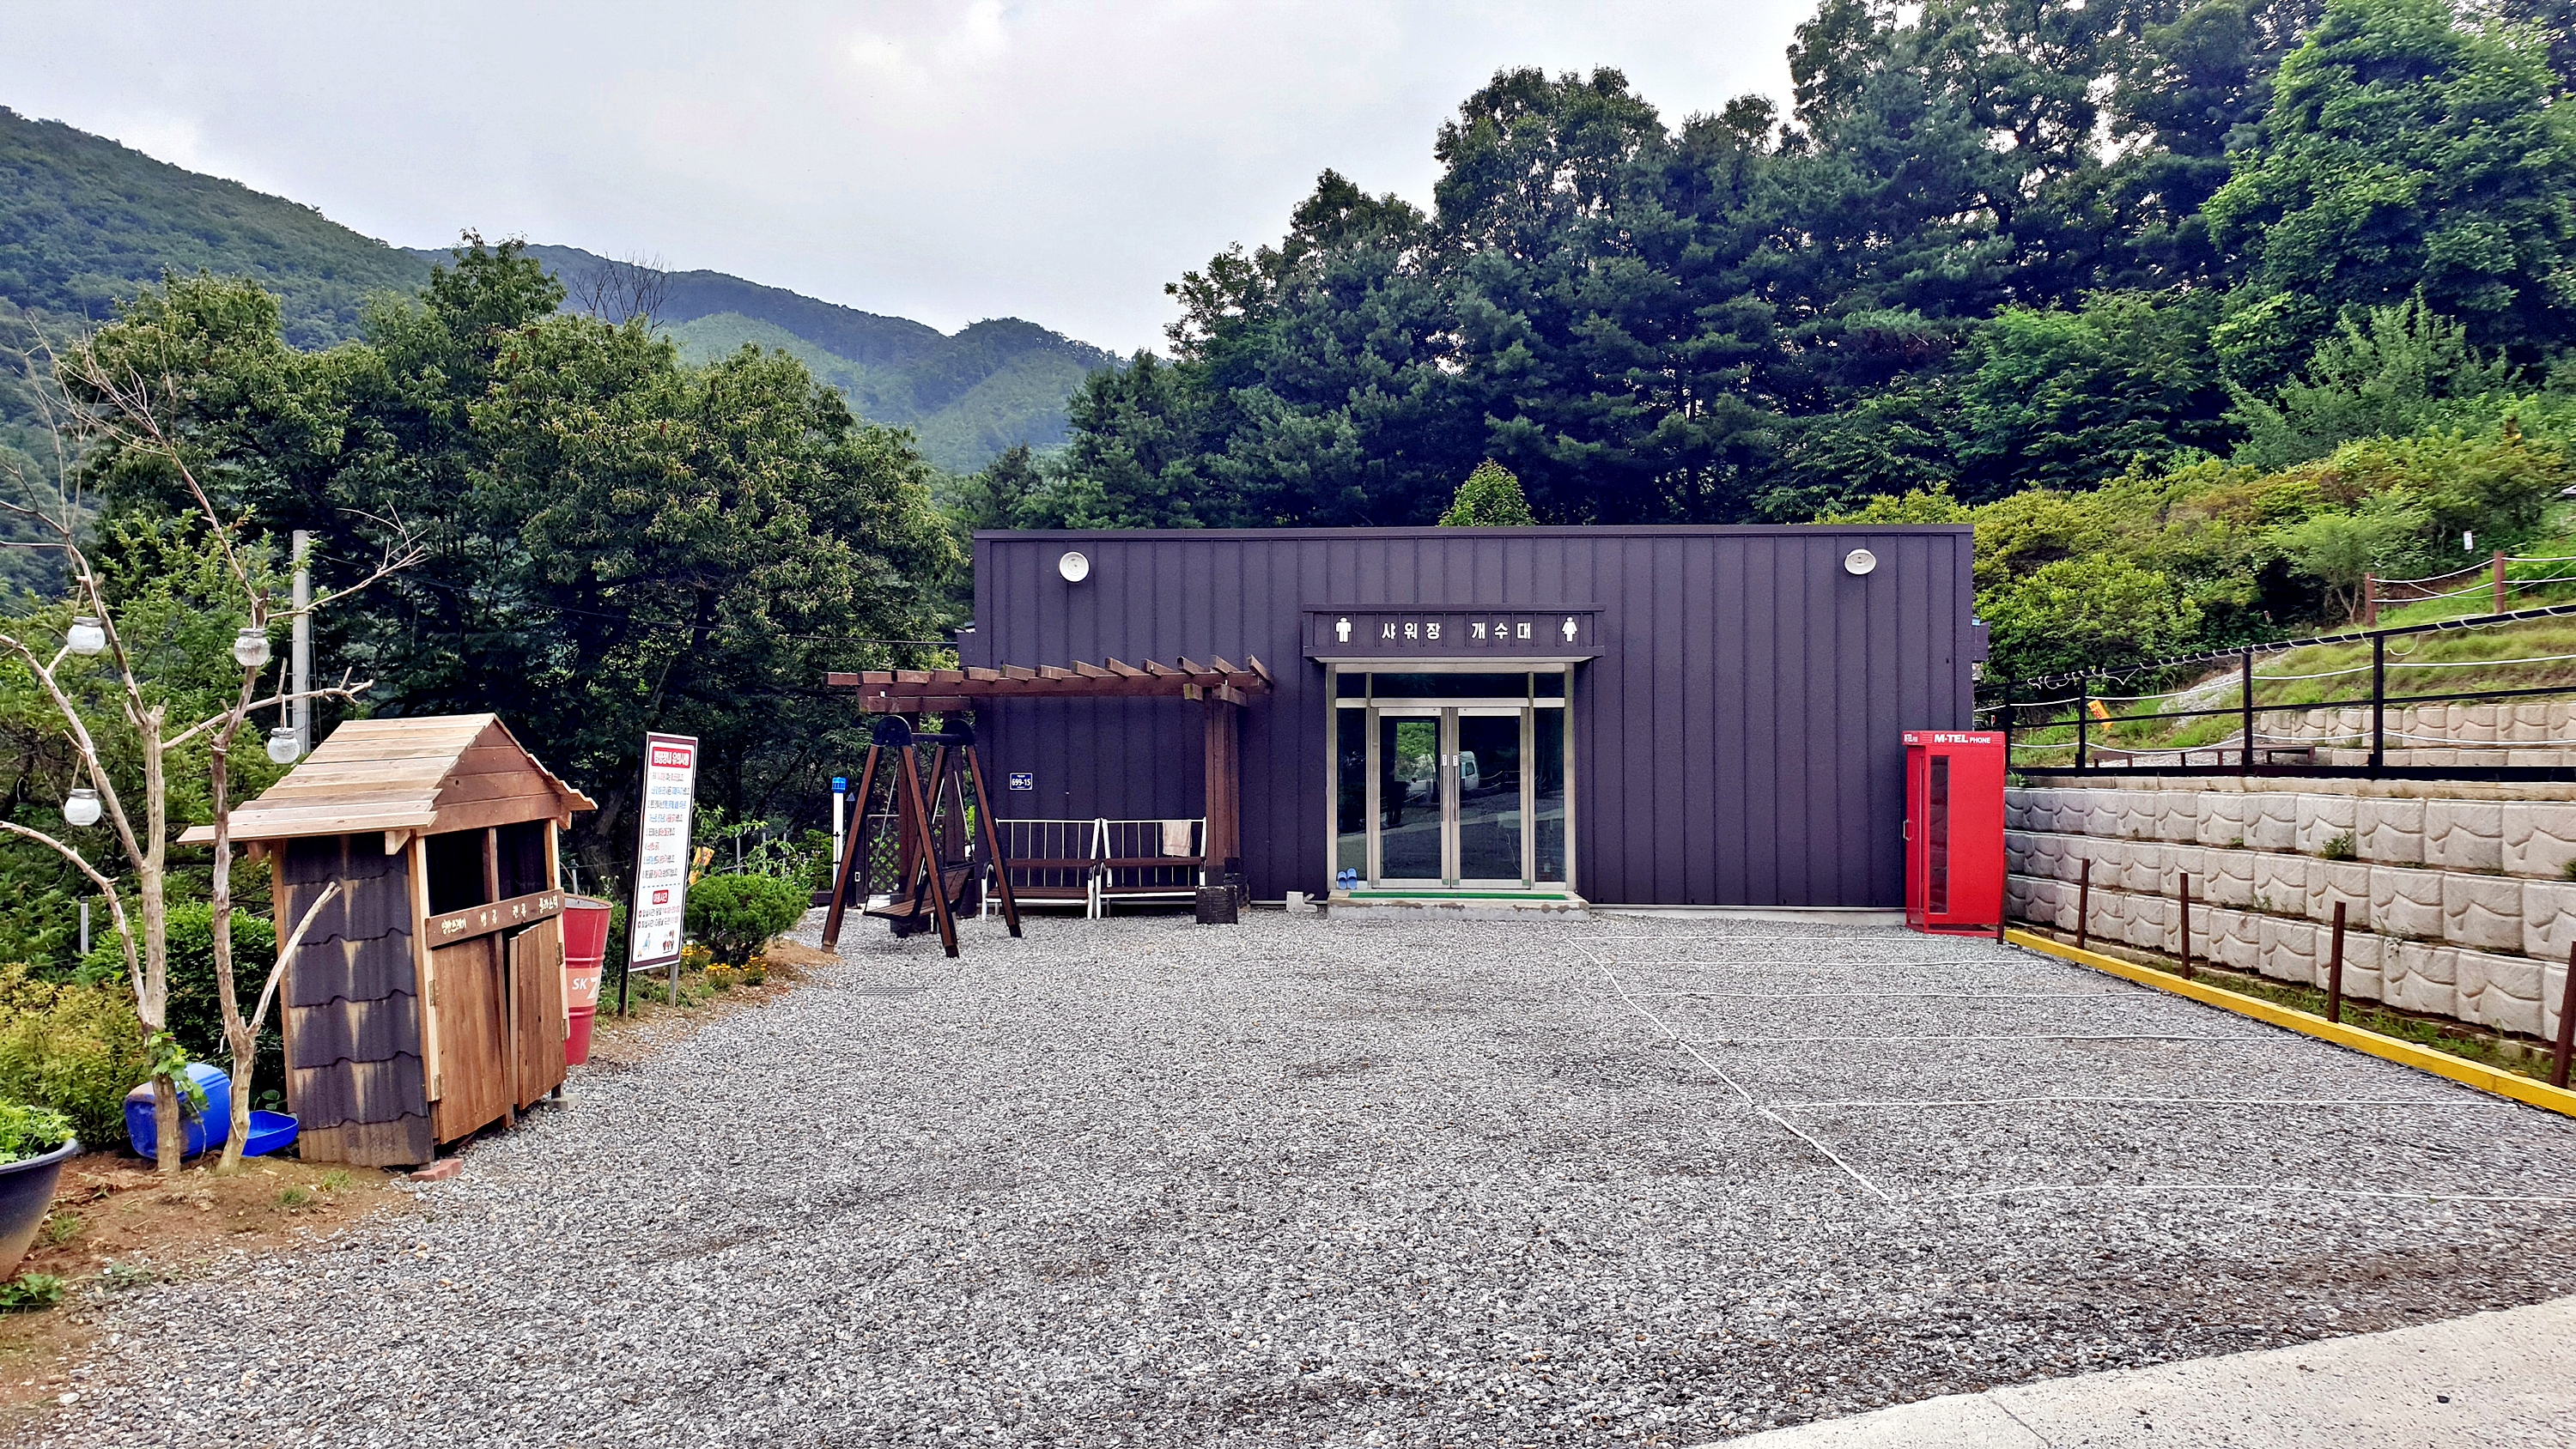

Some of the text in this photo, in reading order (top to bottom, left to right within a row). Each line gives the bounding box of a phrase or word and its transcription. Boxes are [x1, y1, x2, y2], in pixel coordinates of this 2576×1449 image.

[1381, 622, 1531, 640] 샤워장 개수대
[538, 894, 559, 914] 플라스틱
[572, 978, 588, 990] SK
